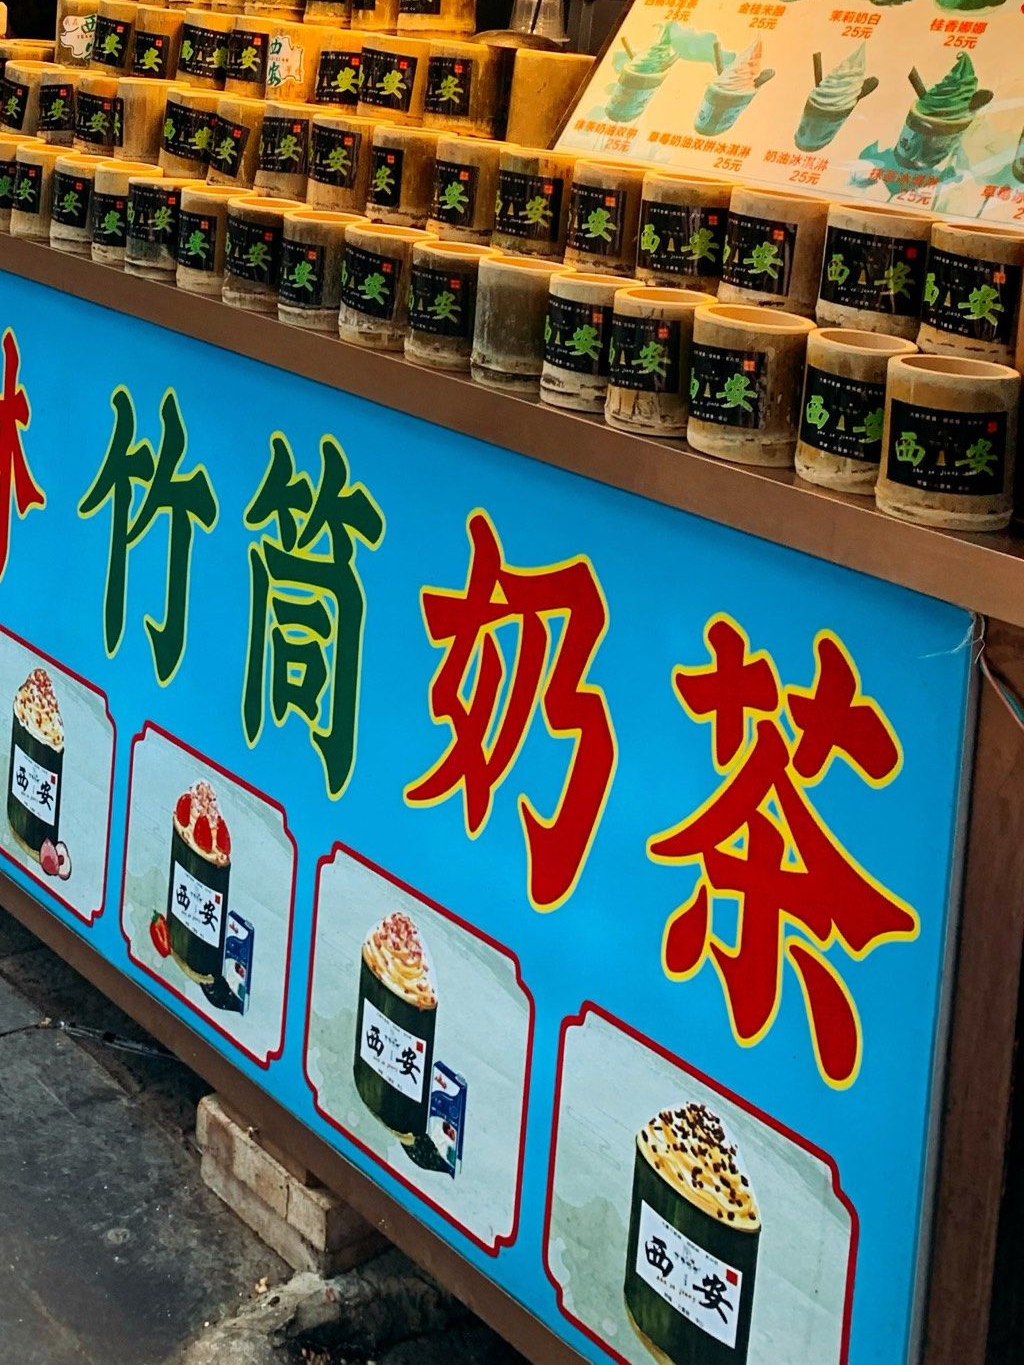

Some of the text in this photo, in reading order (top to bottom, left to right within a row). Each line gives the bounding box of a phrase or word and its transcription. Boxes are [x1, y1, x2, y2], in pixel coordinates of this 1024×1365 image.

[749, 17, 777, 30] 25元
[841, 26, 873, 39] 25元
[943, 35, 977, 49] 25元
[376, 69, 407, 99] 安
[435, 75, 463, 103] 安
[605, 139, 632, 152] 25元
[763, 150, 829, 171] 奶油冰淇淋
[714, 158, 743, 171] 25元
[789, 170, 821, 185] 25元
[439, 181, 469, 213] 安
[896, 190, 932, 205] 25元
[582, 208, 616, 242] 安
[185, 230, 210, 259] 安
[641, 224, 719, 262] 西安
[289, 261, 317, 292] 安
[828, 254, 915, 299] 西安
[895, 431, 998, 476] 西安
[16, 766, 54, 811] 西安
[176, 884, 218, 932] 西安
[366, 1025, 421, 1084] 西安
[645, 1235, 733, 1324] 西安
